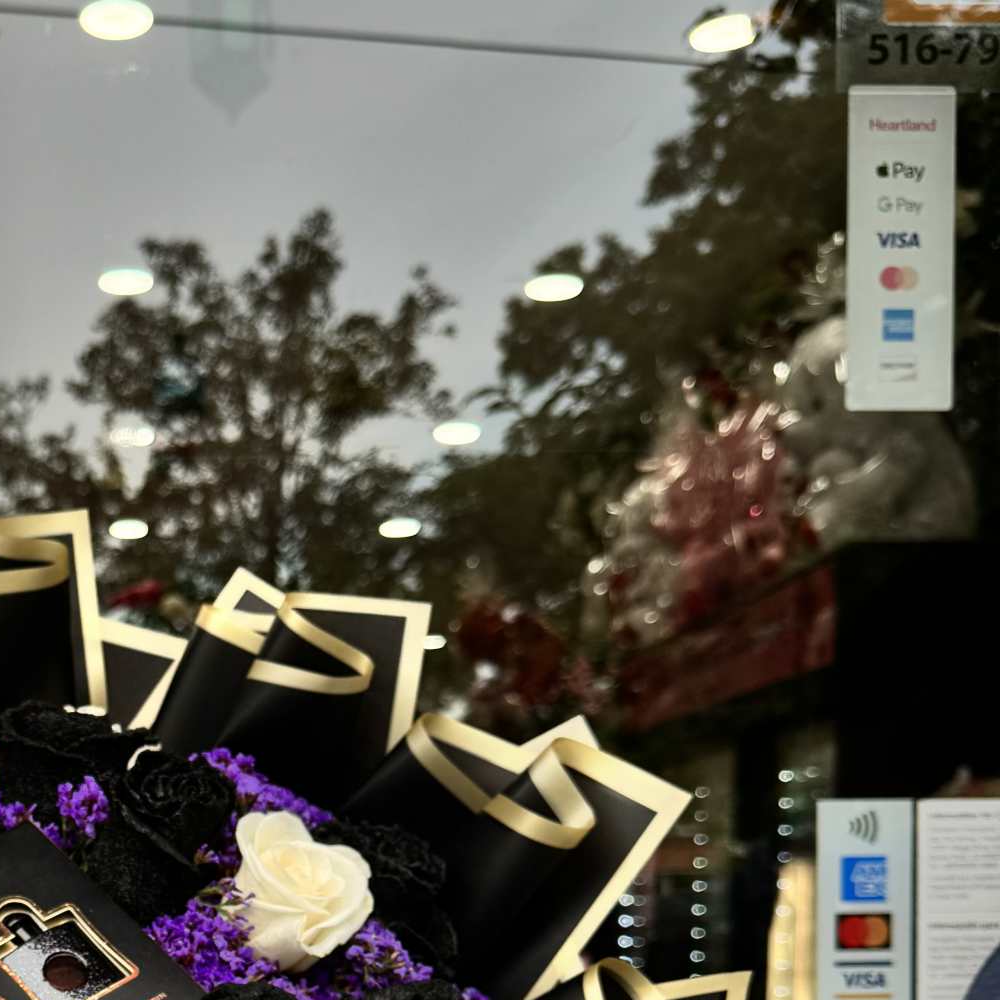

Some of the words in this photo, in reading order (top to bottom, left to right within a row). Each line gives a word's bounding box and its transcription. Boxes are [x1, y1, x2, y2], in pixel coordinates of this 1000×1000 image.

[868, 118, 937, 132] Heartland
[892, 160, 926, 183] Pay
[895, 197, 924, 215] Pay
[877, 231, 921, 249] VISA
[843, 973, 886, 988] VISA
